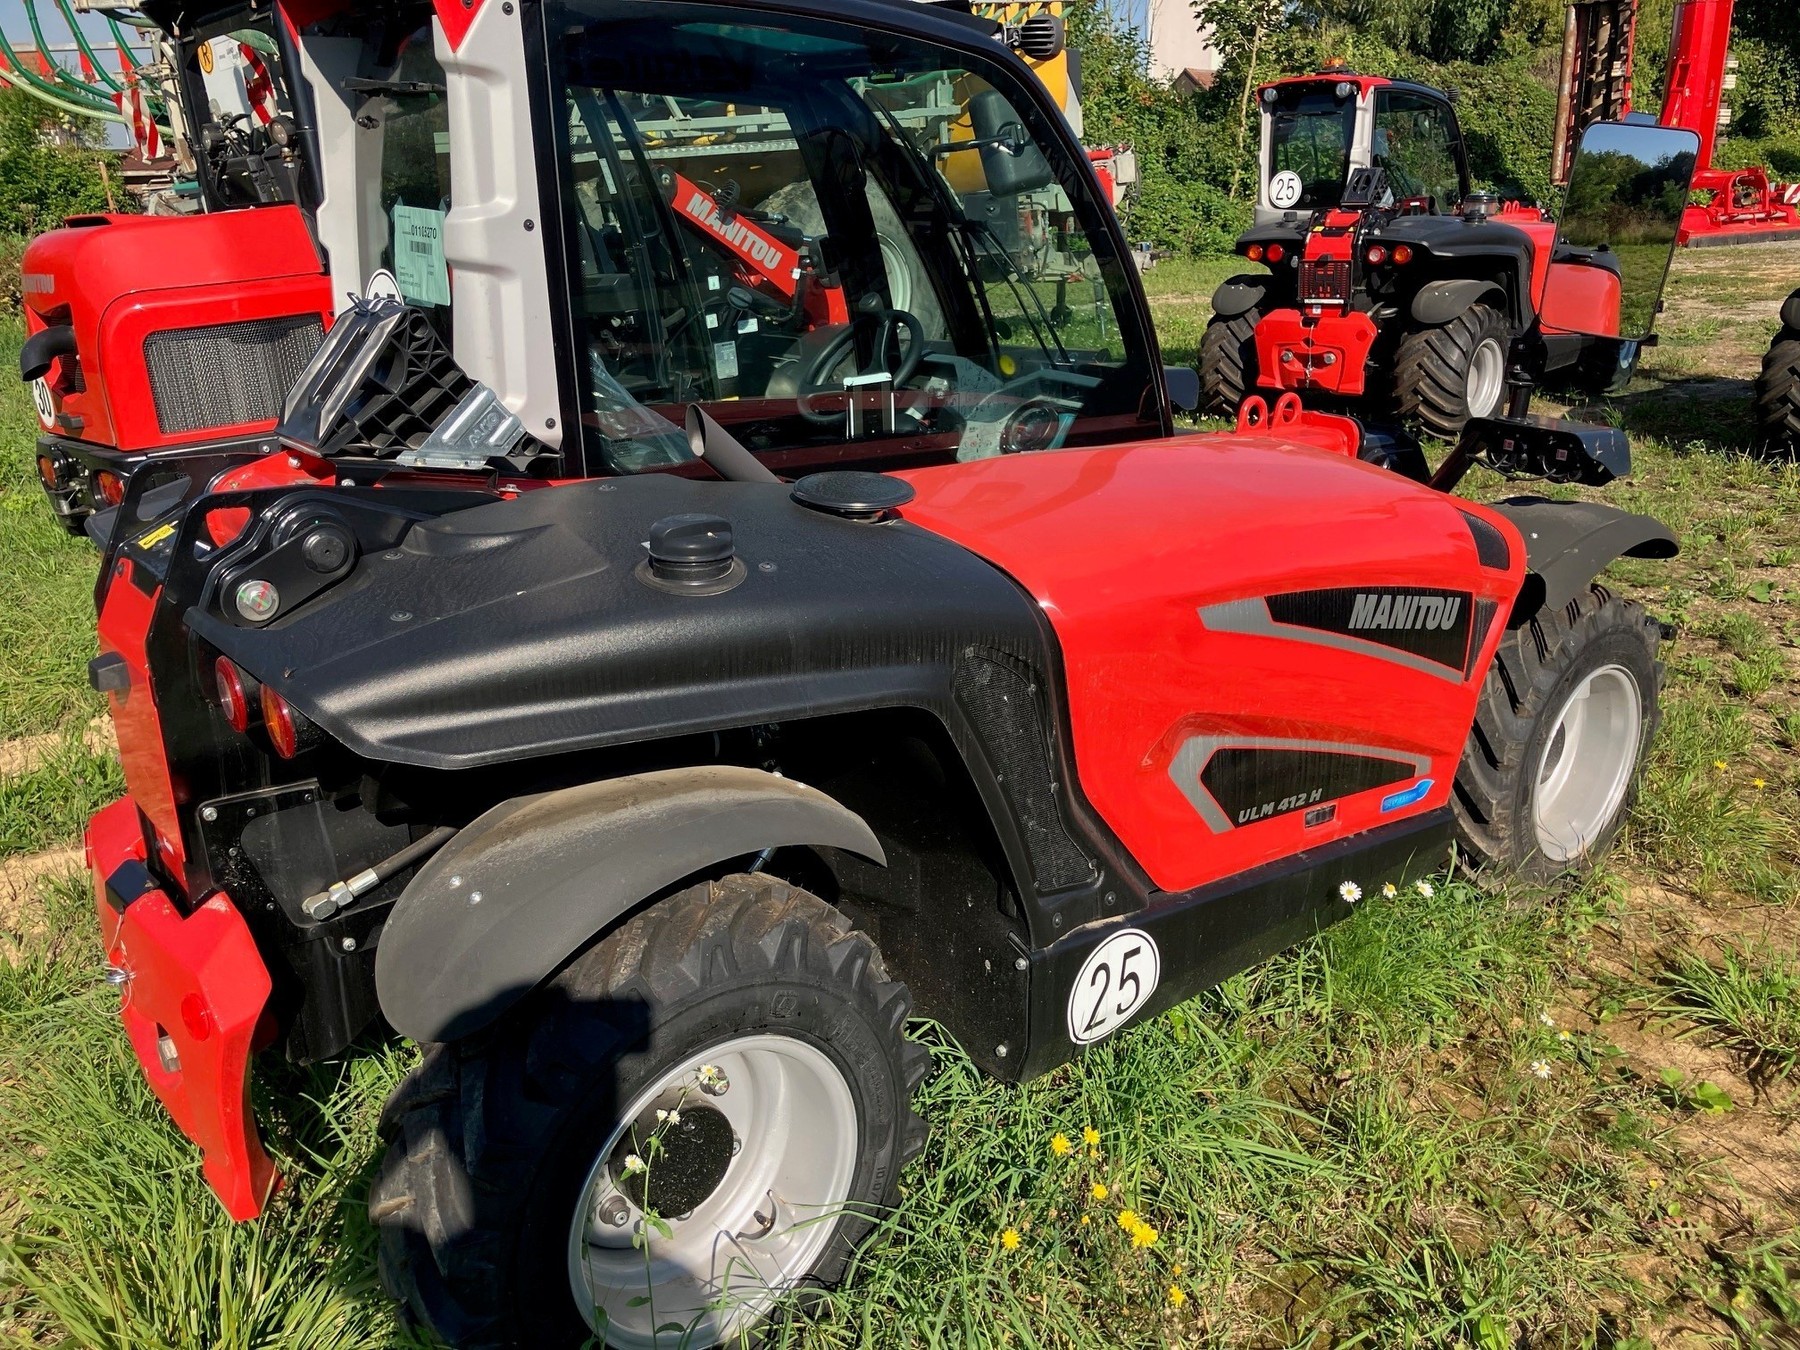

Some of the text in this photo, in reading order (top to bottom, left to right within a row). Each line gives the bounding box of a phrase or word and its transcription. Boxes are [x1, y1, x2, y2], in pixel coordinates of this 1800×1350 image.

[1276, 178, 1295, 201] 25
[686, 192, 783, 270] MANITOU
[35, 380, 52, 418] 30
[1347, 593, 1462, 631] MANITOU
[1238, 788, 1323, 824] ULM 412 H
[1082, 945, 1142, 1034] 25
